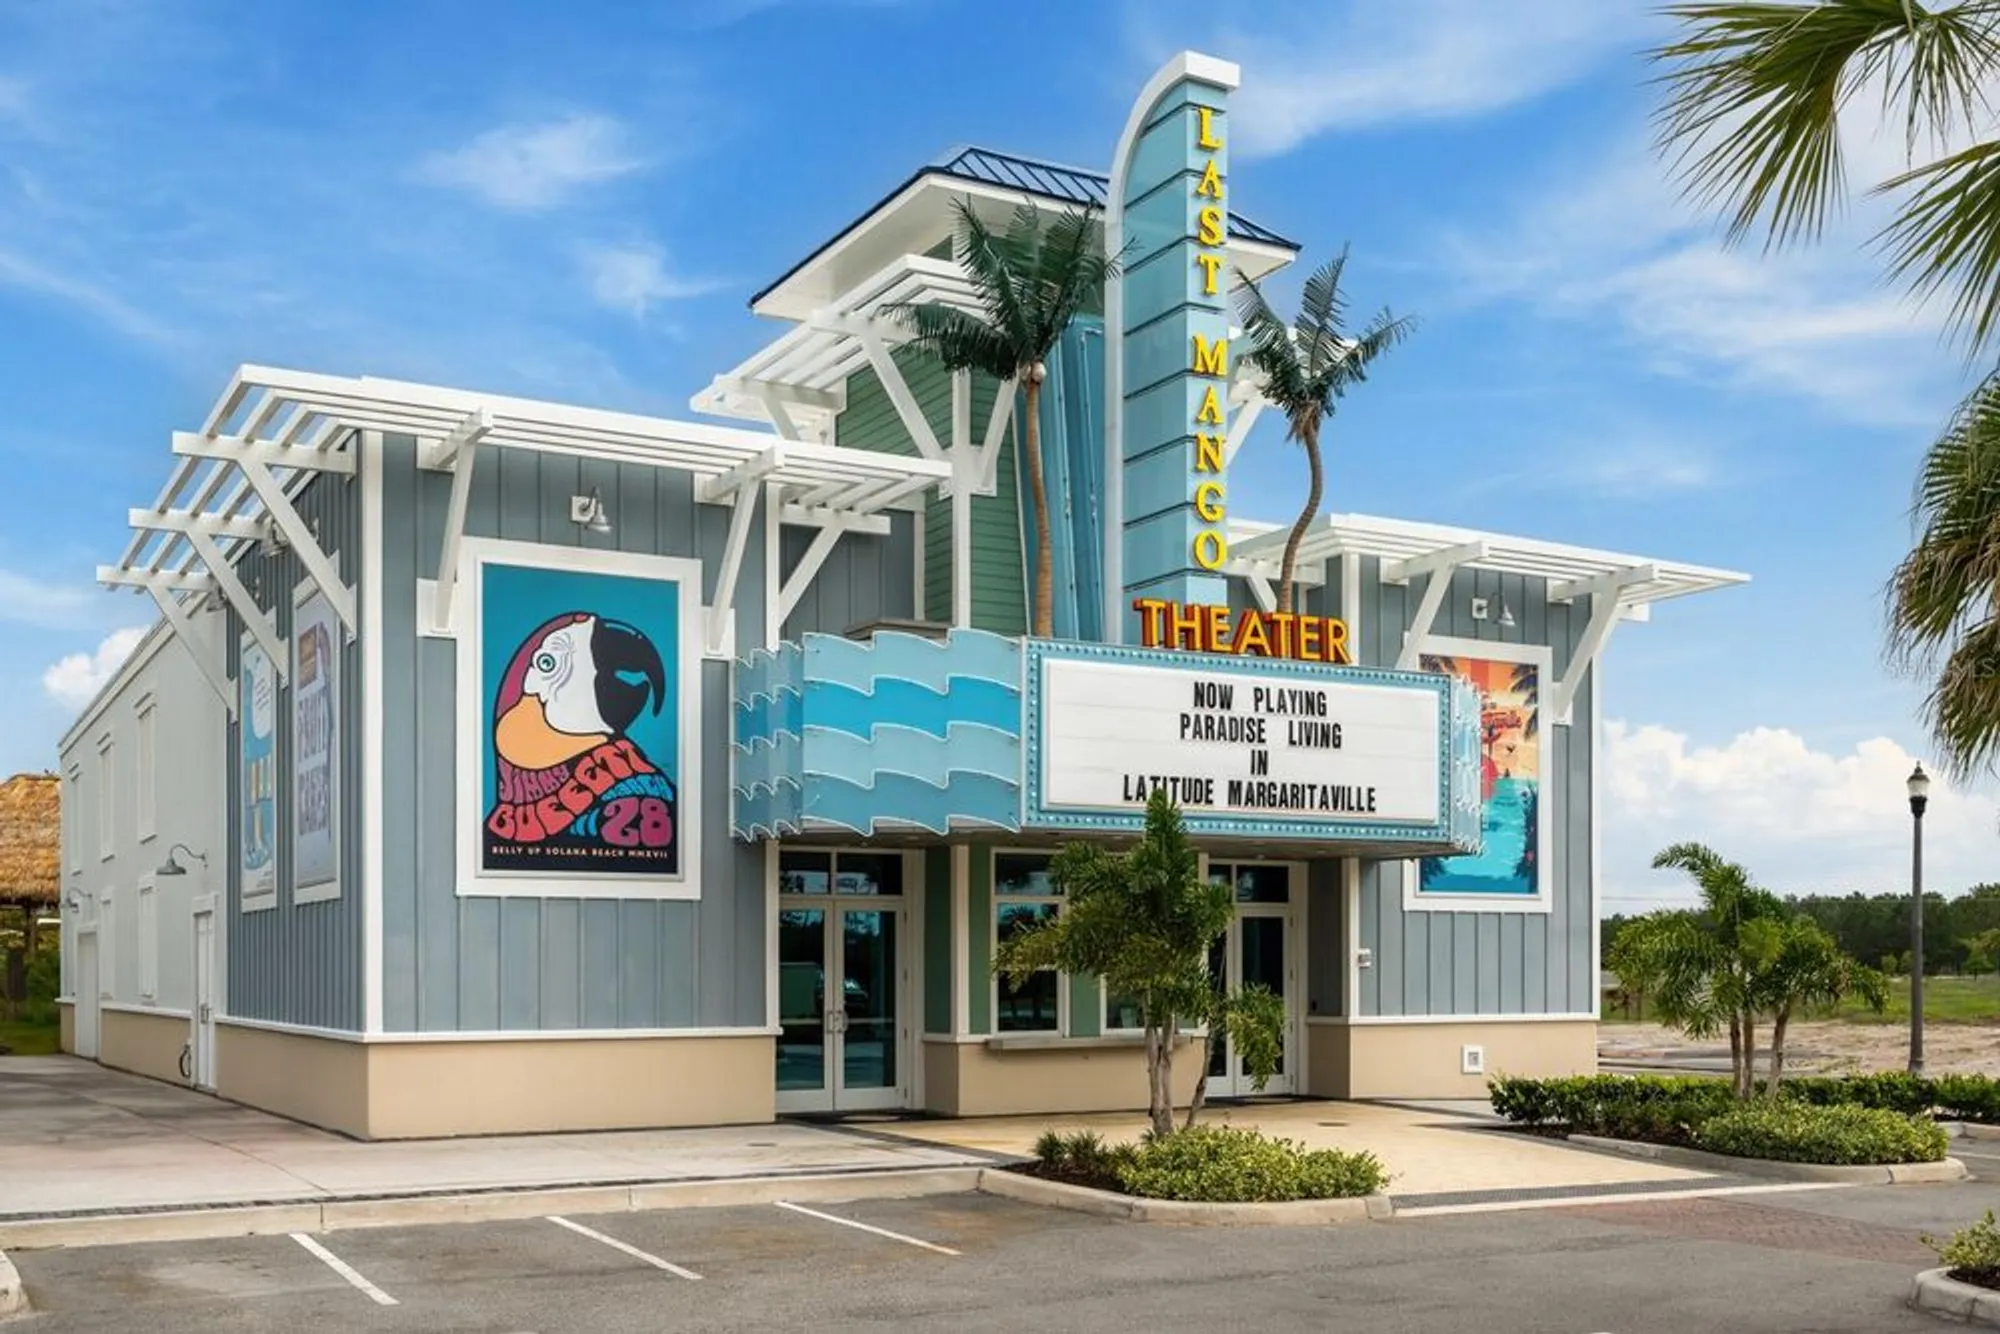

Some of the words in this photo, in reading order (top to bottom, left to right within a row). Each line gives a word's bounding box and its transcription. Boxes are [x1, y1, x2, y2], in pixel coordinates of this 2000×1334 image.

[1197, 106, 1225, 297] LAST
[1191, 332, 1228, 571] MANGO
[1133, 598, 1354, 666] THEATER
[1193, 681, 1234, 711] NOW
[1253, 687, 1328, 717] PLAYING
[1179, 713, 1267, 744] PARADISE
[1287, 720, 1343, 750] LIVING
[498, 757, 571, 804] JIMMY
[1249, 749, 1269, 776] IN
[1227, 779, 1377, 812] MARGARITAVILLE
[600, 797, 673, 847] 28
[491, 845, 523, 855] BELLY
[527, 846, 542, 856] UP
[545, 846, 588, 857] SOLANA
[591, 847, 625, 858] BEACH
